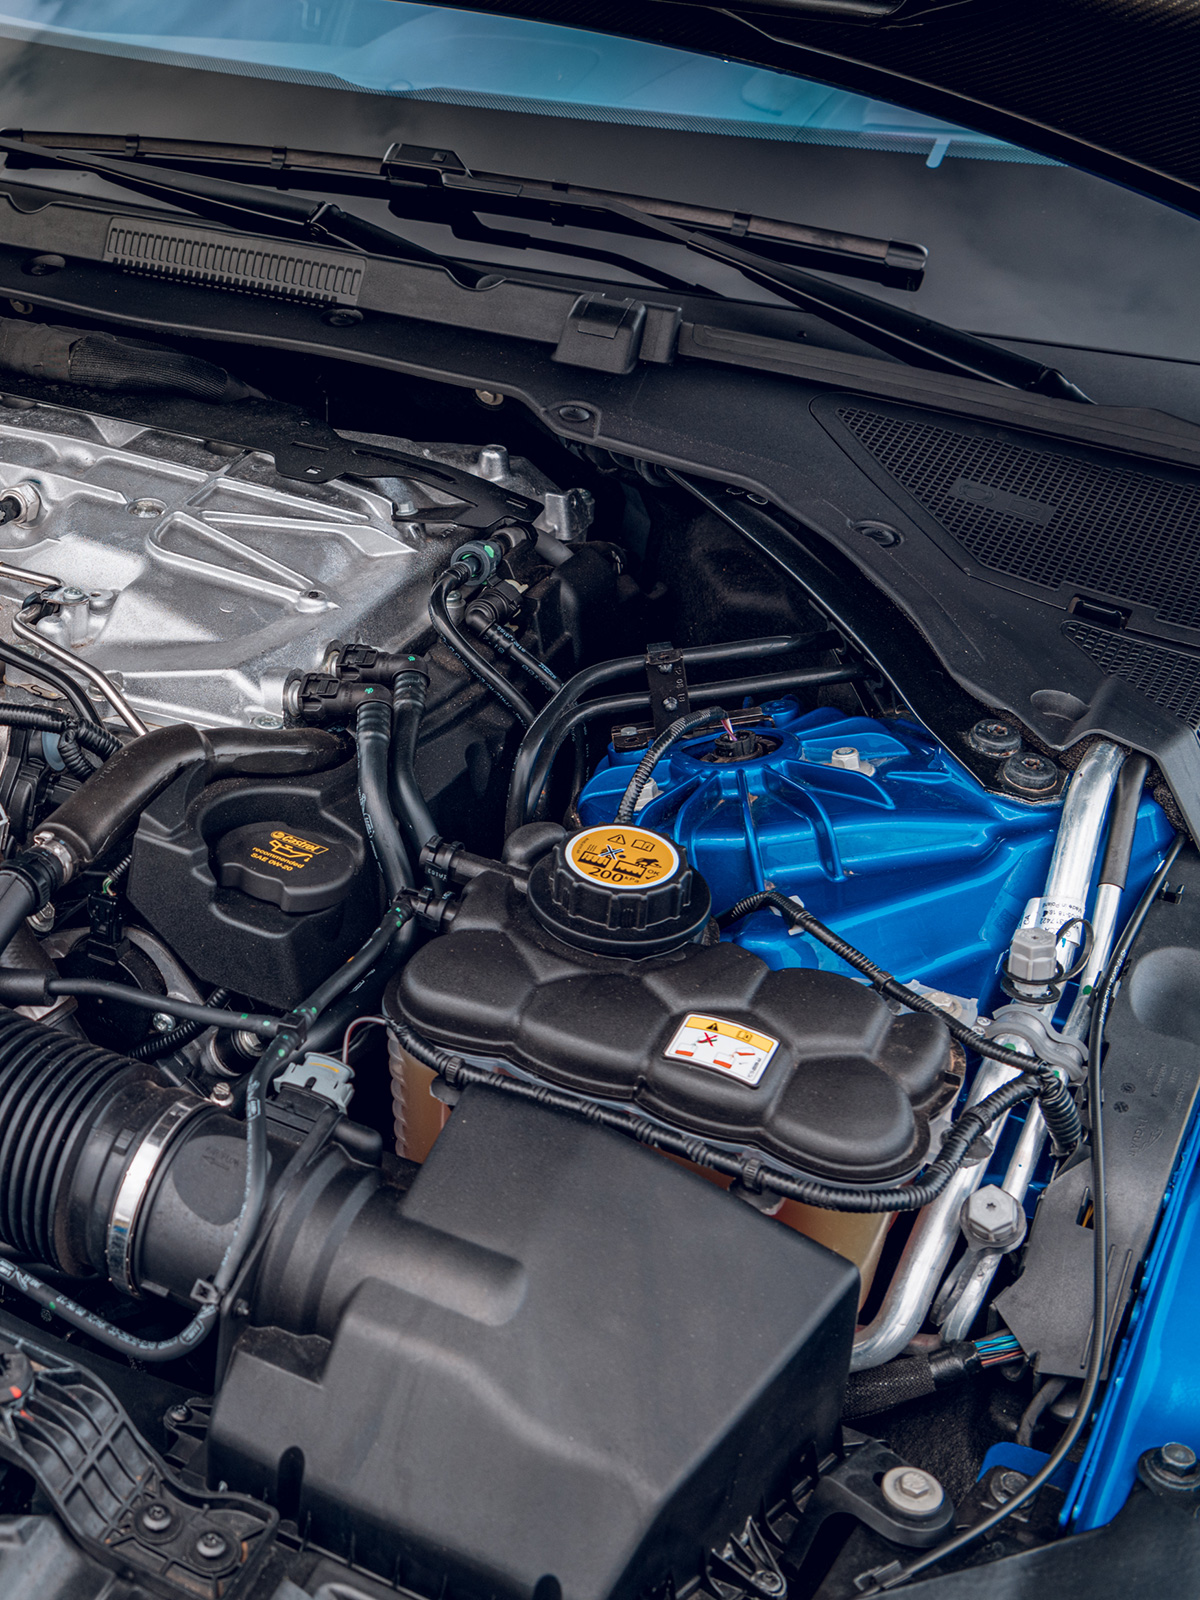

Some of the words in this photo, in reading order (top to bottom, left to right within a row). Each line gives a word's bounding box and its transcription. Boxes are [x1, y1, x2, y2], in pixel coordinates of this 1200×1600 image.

[250, 852, 269, 862] SAE
[268, 859, 294, 872] 0W-20
[252, 847, 305, 869] recommended
[588, 866, 624, 882] 200
